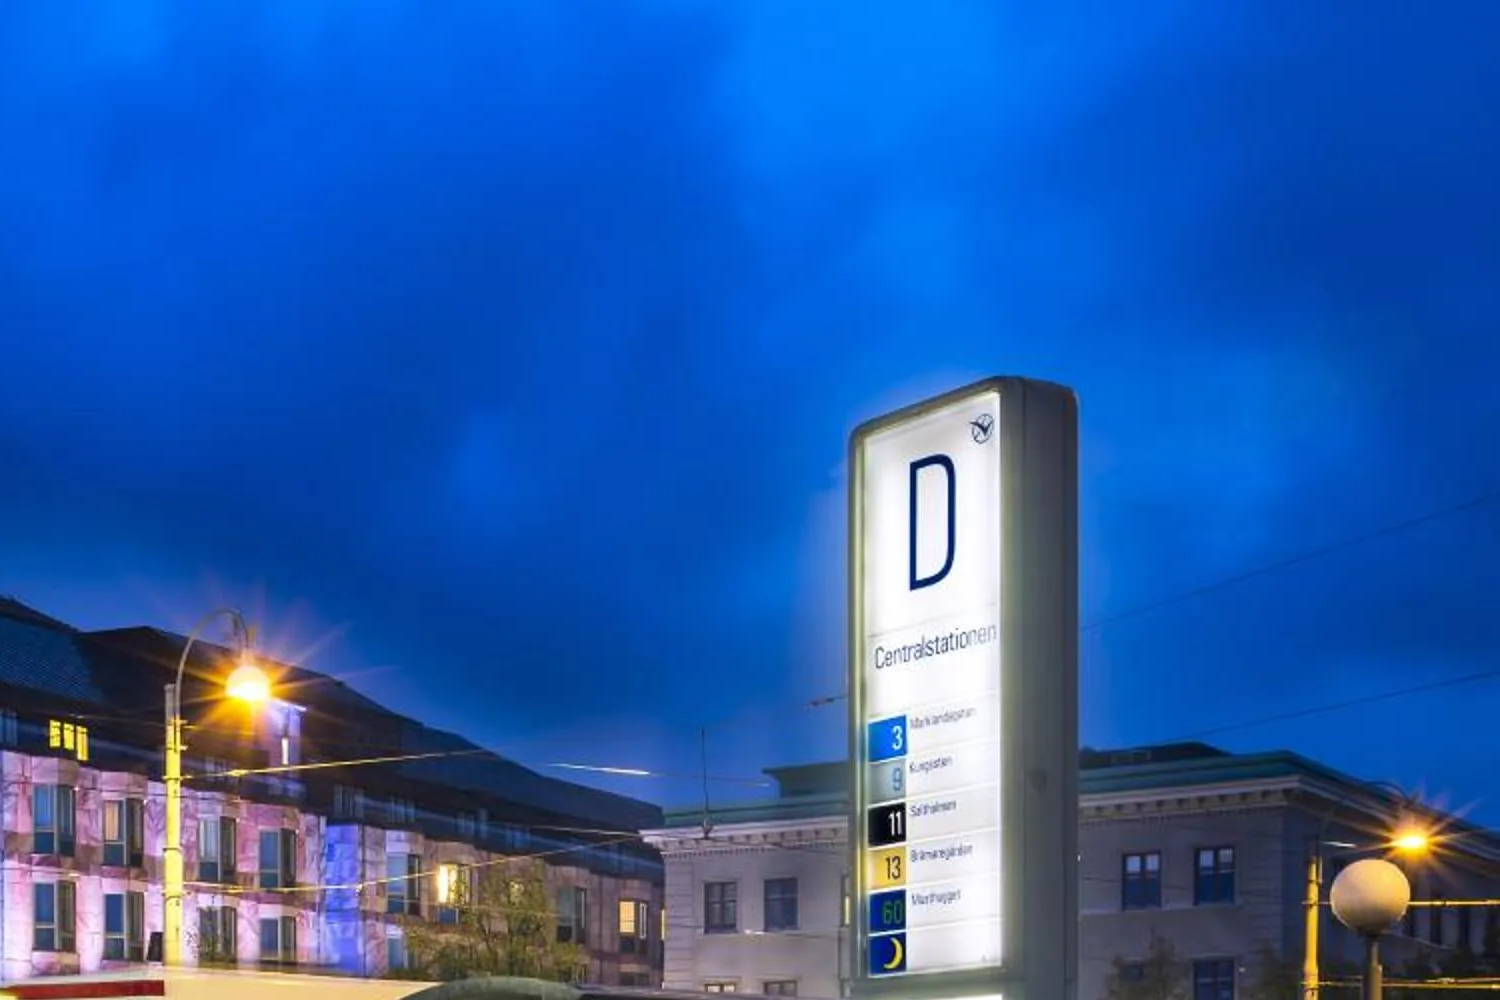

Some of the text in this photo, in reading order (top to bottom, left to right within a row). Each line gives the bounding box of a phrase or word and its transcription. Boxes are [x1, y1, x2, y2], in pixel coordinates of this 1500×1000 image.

[909, 453, 956, 591] D
[874, 623, 997, 670] Centralstationen
[891, 725, 904, 750] 3
[892, 767, 903, 792] 9
[888, 811, 903, 836] 11
[885, 856, 902, 880] 13
[882, 900, 904, 925] 60
